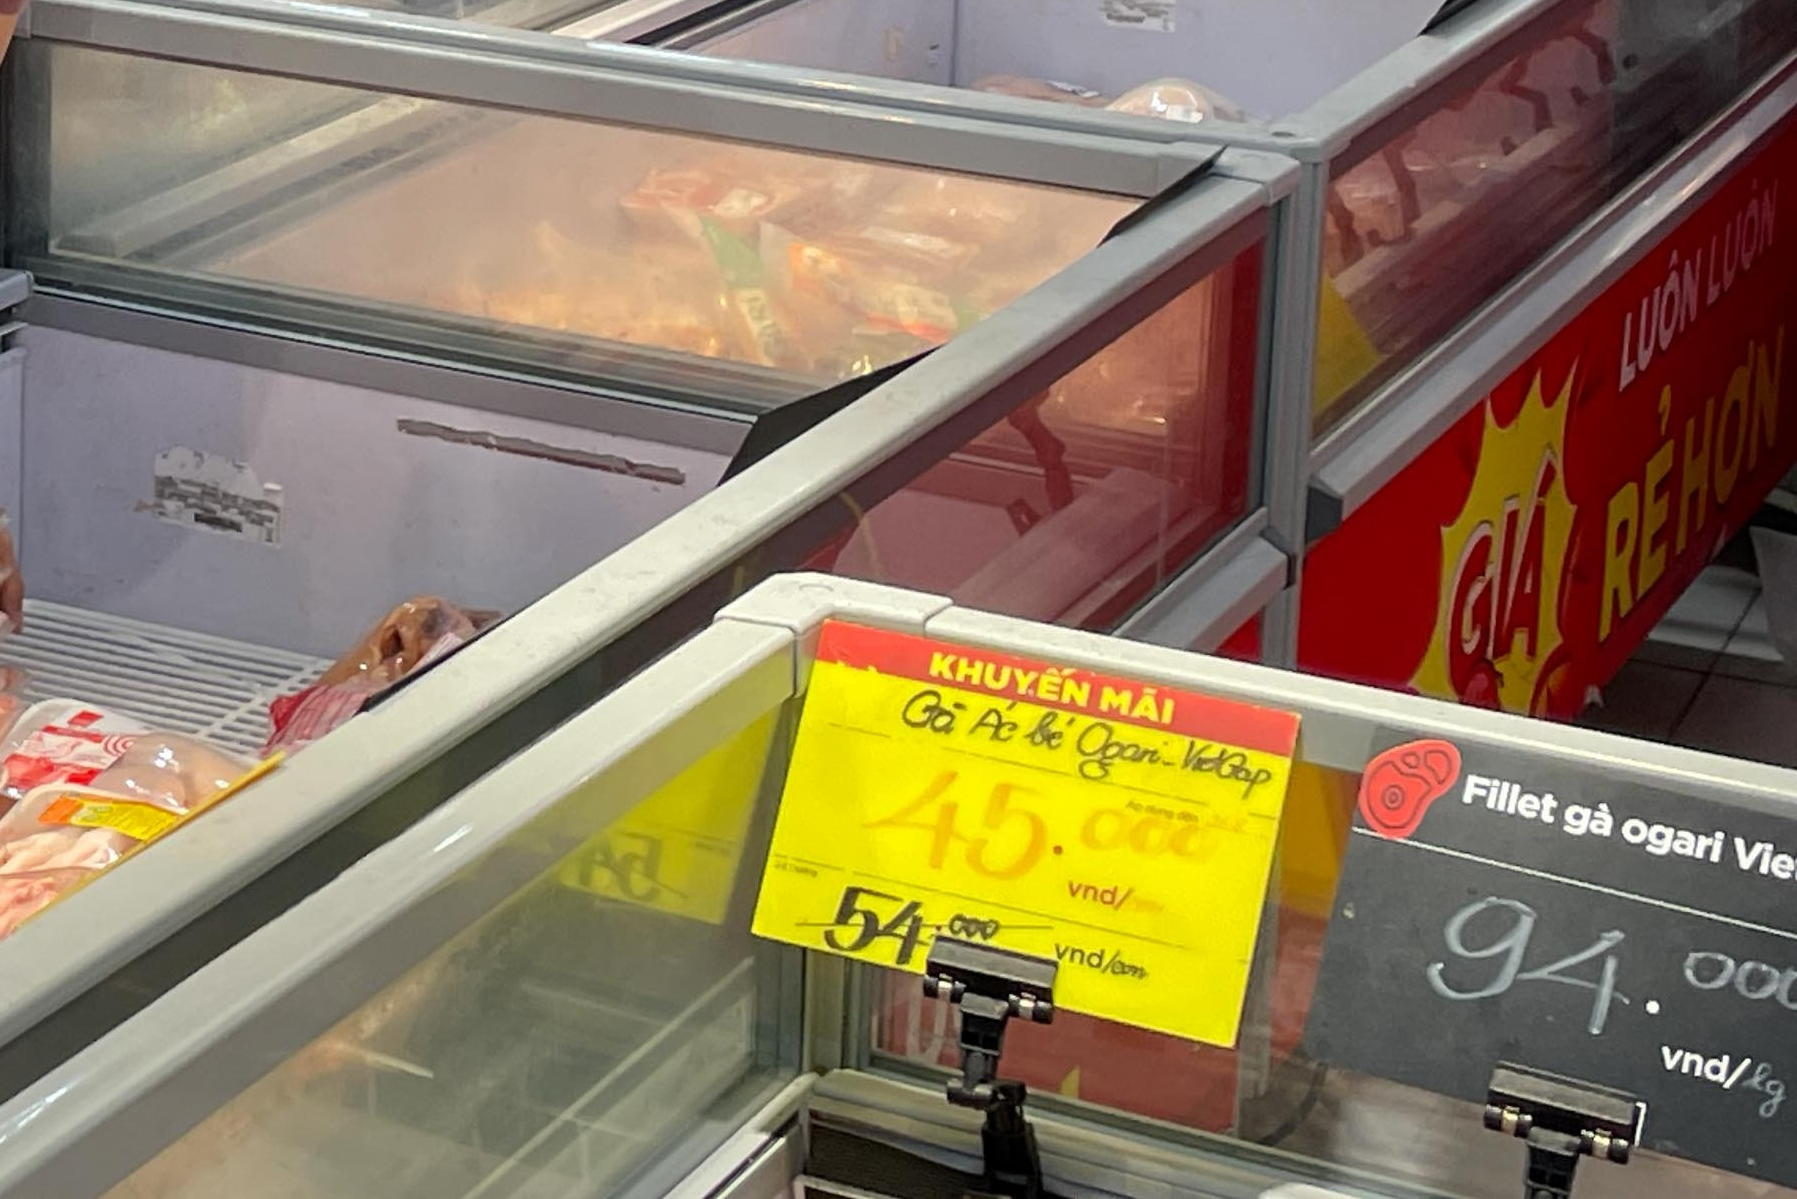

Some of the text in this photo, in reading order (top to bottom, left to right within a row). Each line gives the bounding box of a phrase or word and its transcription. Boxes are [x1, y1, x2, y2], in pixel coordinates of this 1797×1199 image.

[1618, 179, 1779, 392] LUÔN LUÔN
[1599, 323, 1786, 642] RẺ HƠN
[929, 652, 1175, 725] KHUYẾN MÃI
[1462, 774, 1797, 880] Fillet gà ogari Vie
